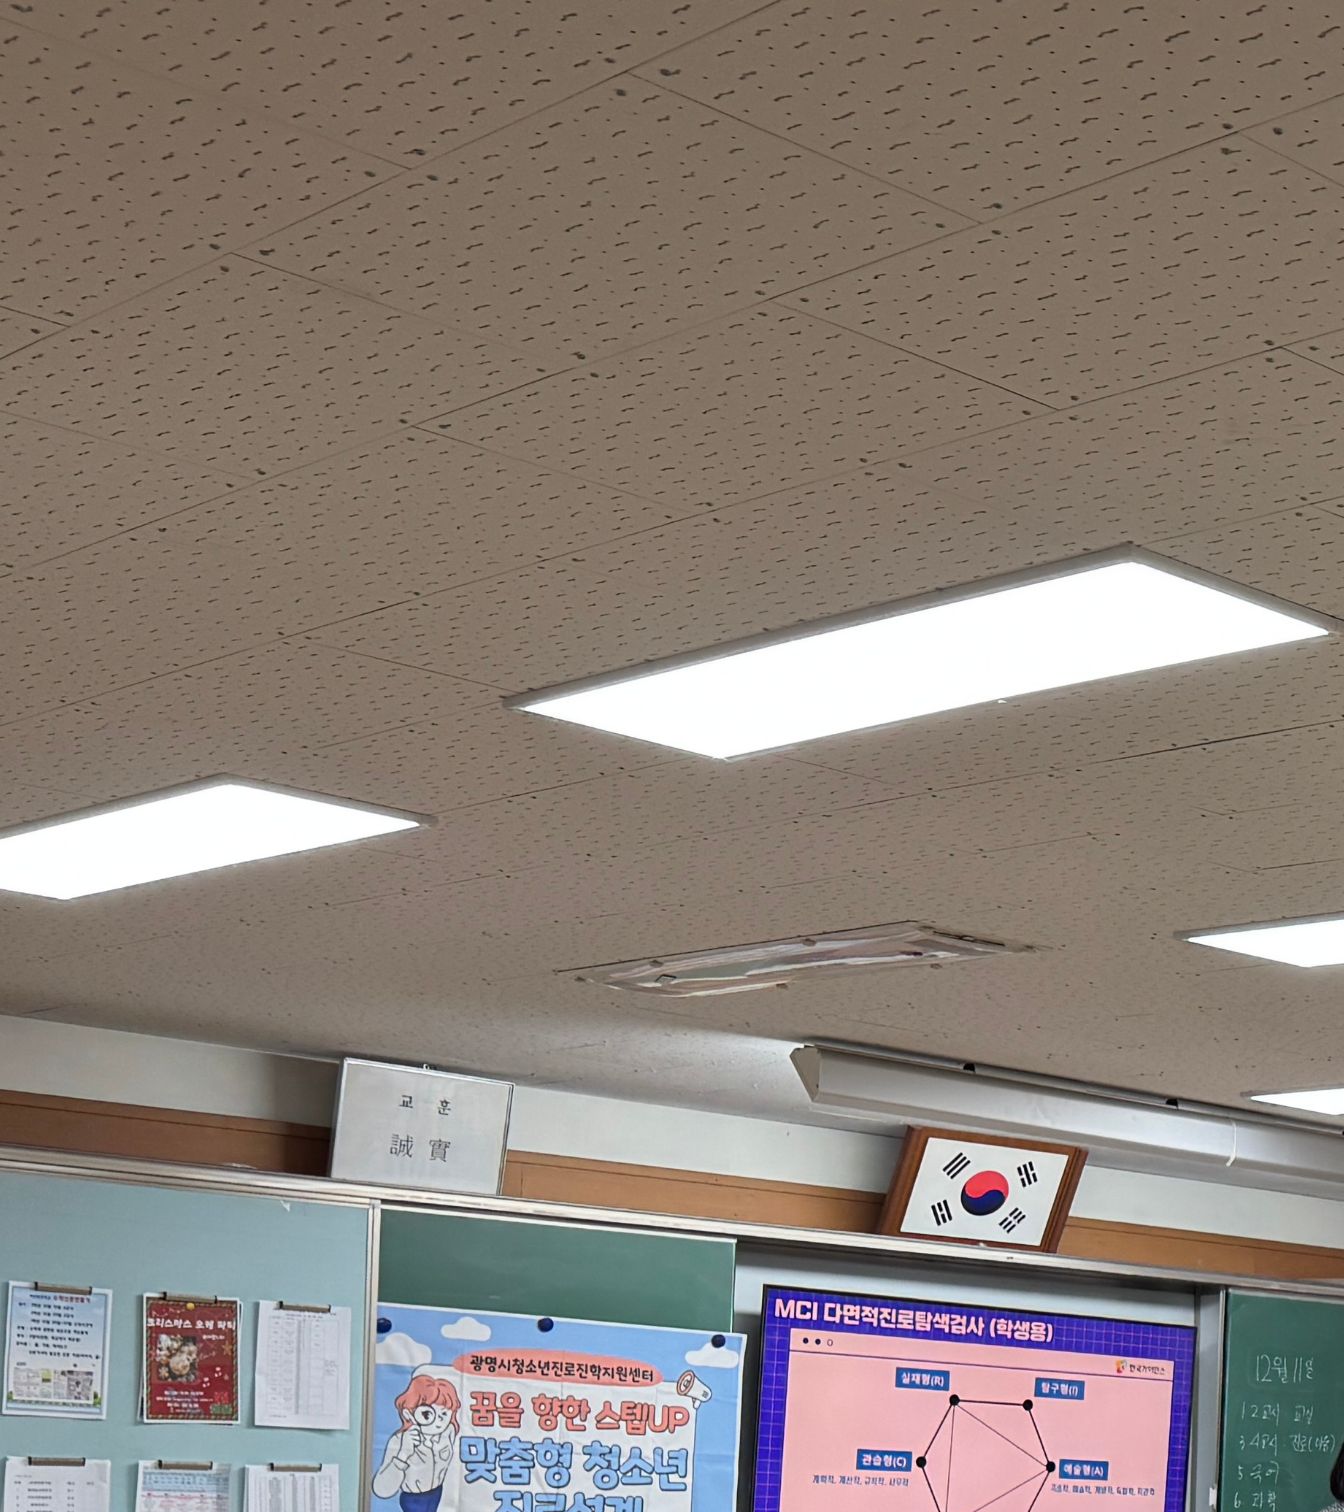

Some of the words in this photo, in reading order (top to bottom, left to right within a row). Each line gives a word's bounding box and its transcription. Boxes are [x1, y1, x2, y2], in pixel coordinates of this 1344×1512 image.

[774, 1298, 818, 1321] MCI
[823, 1302, 985, 1336] 다면적진로탐색검사
[989, 1319, 1053, 1343] (학생용)
[470, 1355, 654, 1382] 광명시청소년진로진학지원센터
[1256, 1353, 1289, 1384] 12월
[470, 1391, 524, 1428] 꿈을
[531, 1393, 591, 1432] 향한
[595, 1400, 690, 1435] 스텝UP
[459, 1436, 573, 1488] 맞춤형
[582, 1440, 688, 1492] 청소년
